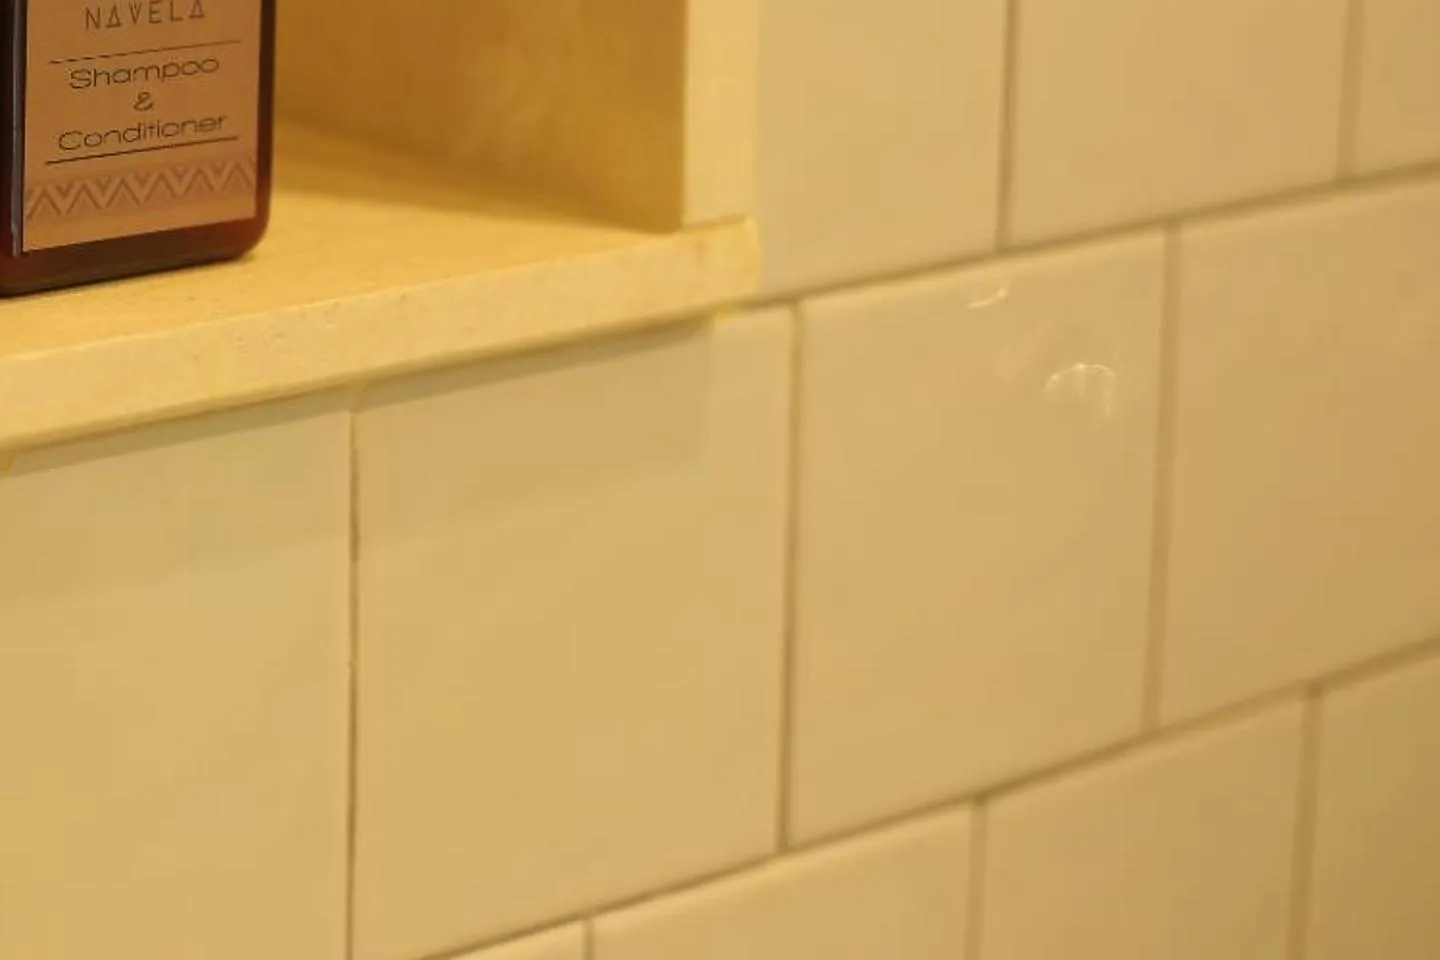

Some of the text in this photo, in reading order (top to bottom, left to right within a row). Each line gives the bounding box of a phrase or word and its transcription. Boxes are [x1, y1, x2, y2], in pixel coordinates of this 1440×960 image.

[69, 57, 220, 90] Shampoo
[133, 91, 154, 112] &
[58, 115, 228, 152] Conditioner
